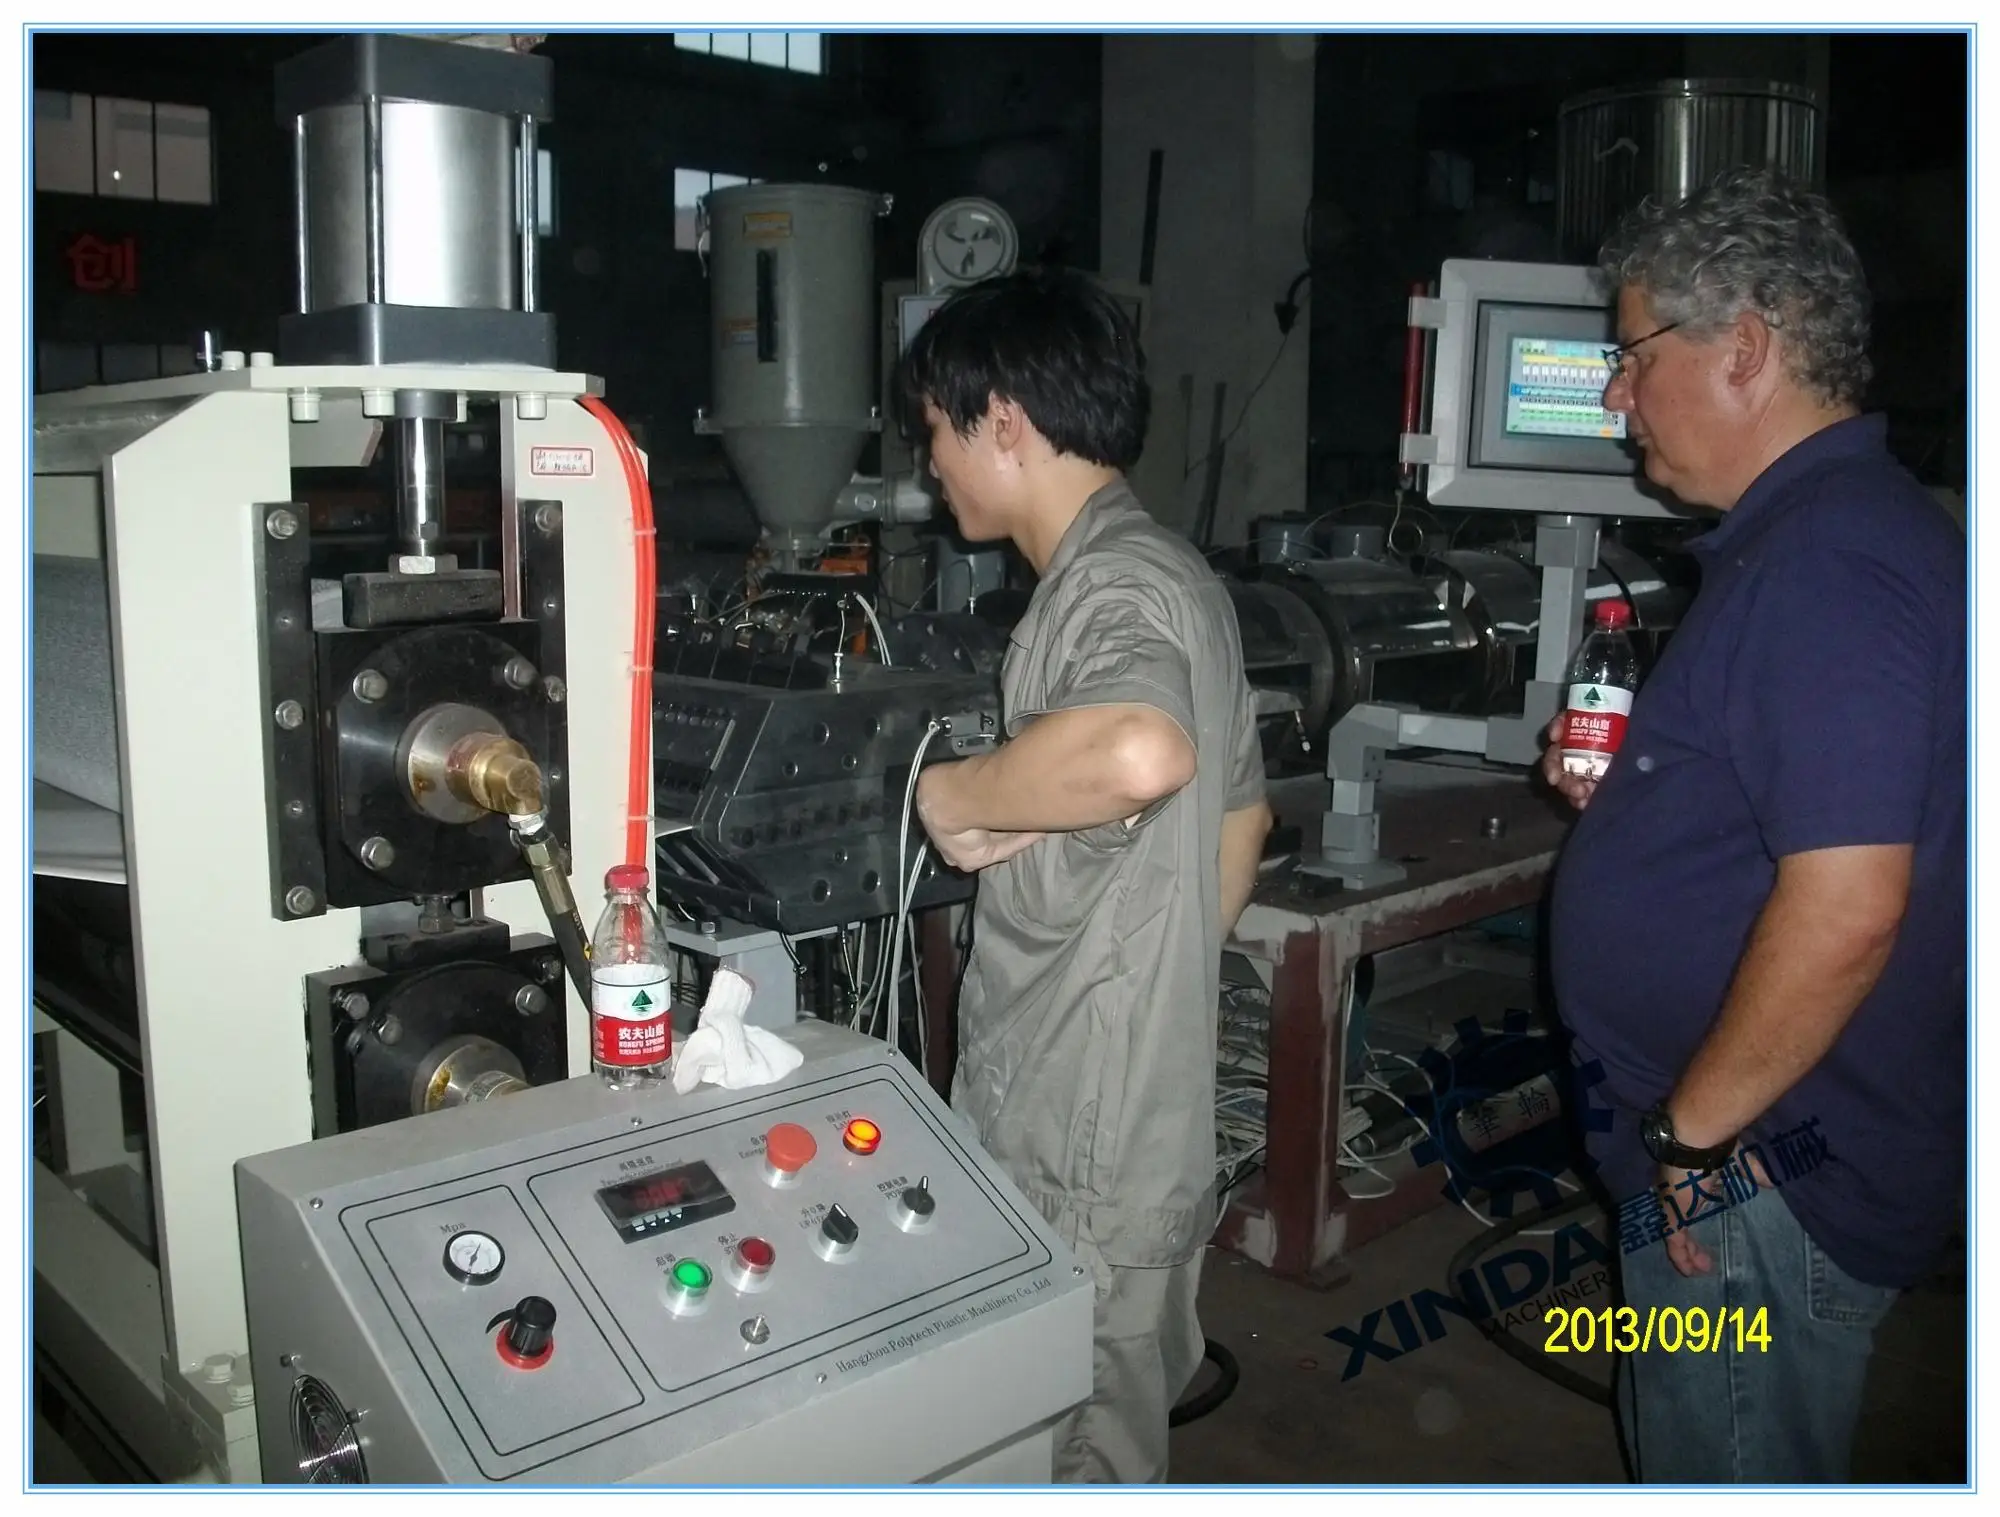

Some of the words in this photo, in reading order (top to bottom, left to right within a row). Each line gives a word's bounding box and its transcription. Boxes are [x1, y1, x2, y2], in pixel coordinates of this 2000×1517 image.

[66, 233, 136, 294] 创
[617, 1022, 665, 1041] 农夫山泉
[440, 1222, 466, 1235] Mpa
[836, 1349, 890, 1373] Hangzhou
[888, 1326, 936, 1352] Polytech
[932, 1311, 970, 1333] Plastic
[967, 1293, 1018, 1320] Machinery
